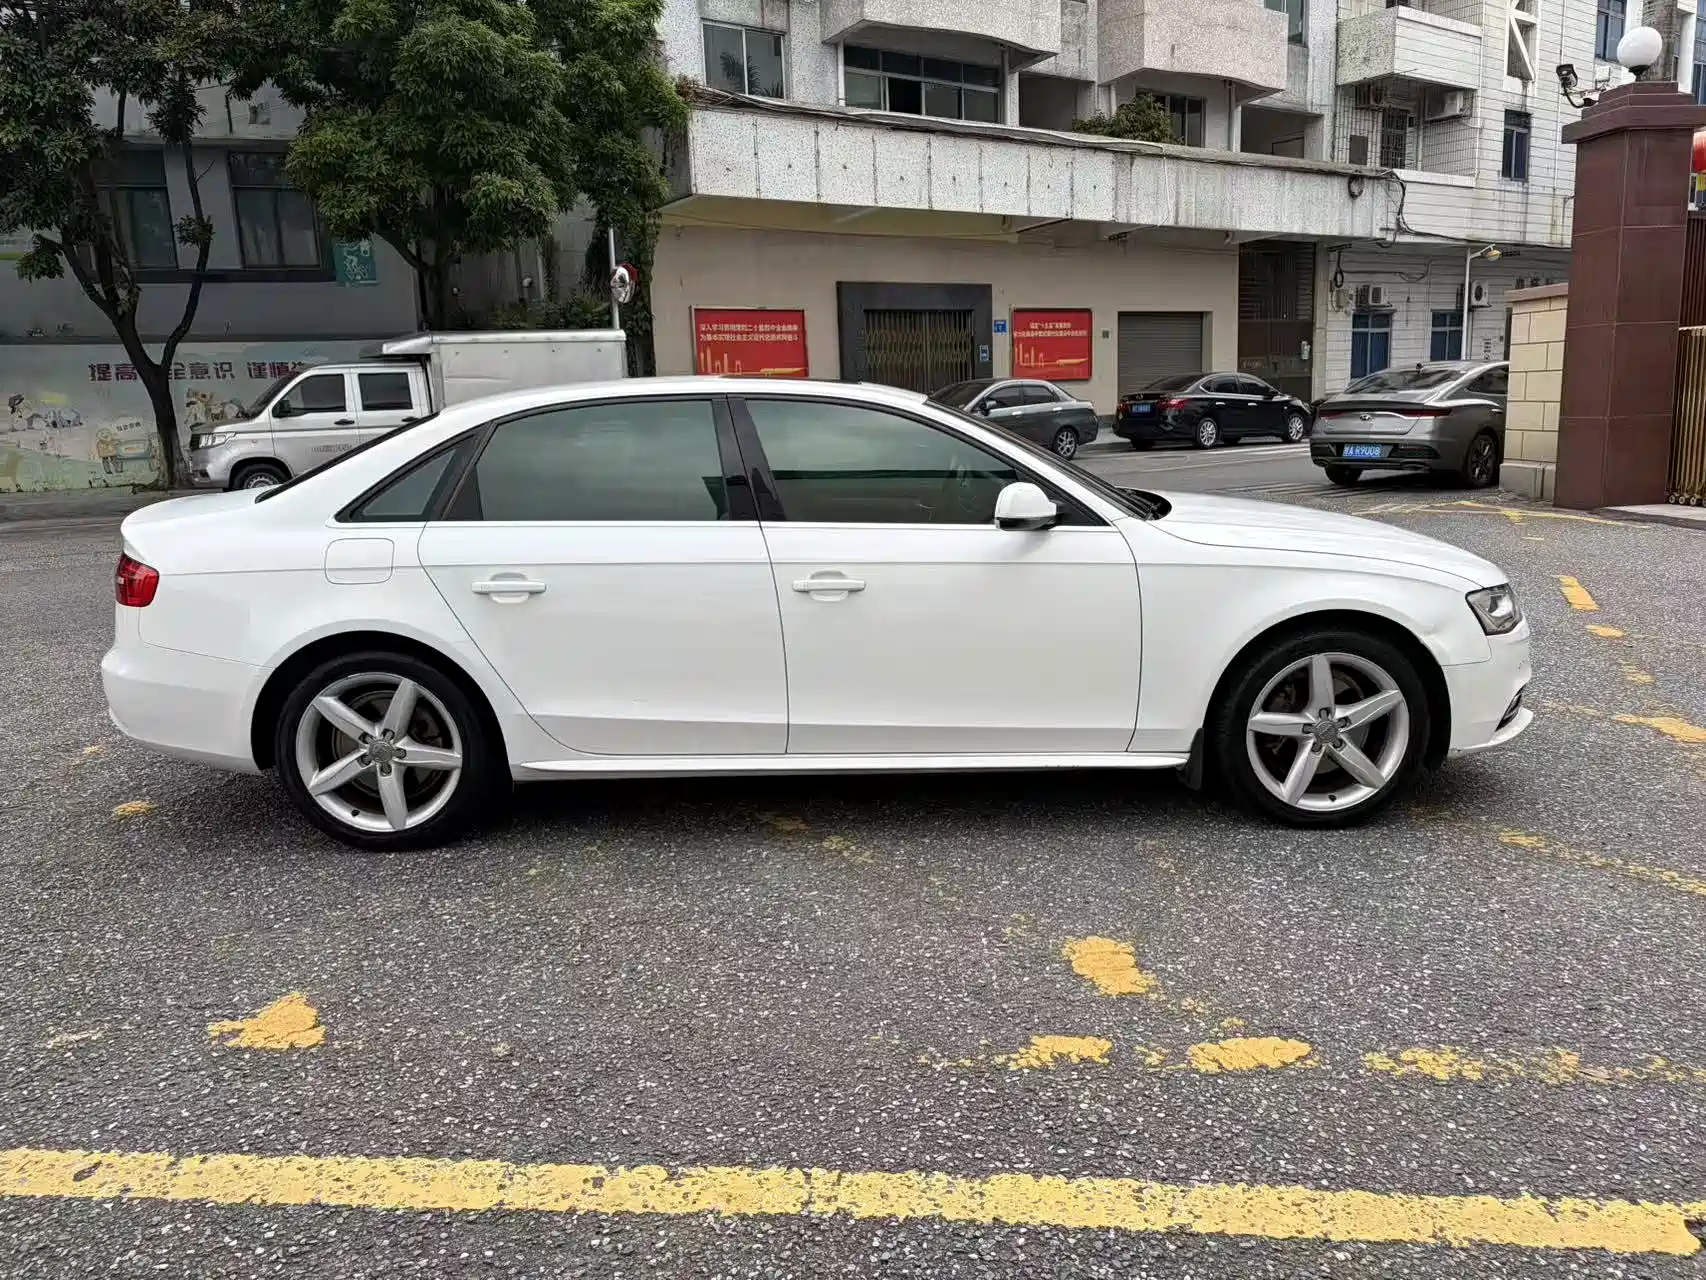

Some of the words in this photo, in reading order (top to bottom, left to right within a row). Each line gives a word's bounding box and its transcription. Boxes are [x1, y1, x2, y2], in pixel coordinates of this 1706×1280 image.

[88, 361, 235, 382] 提高全意识
